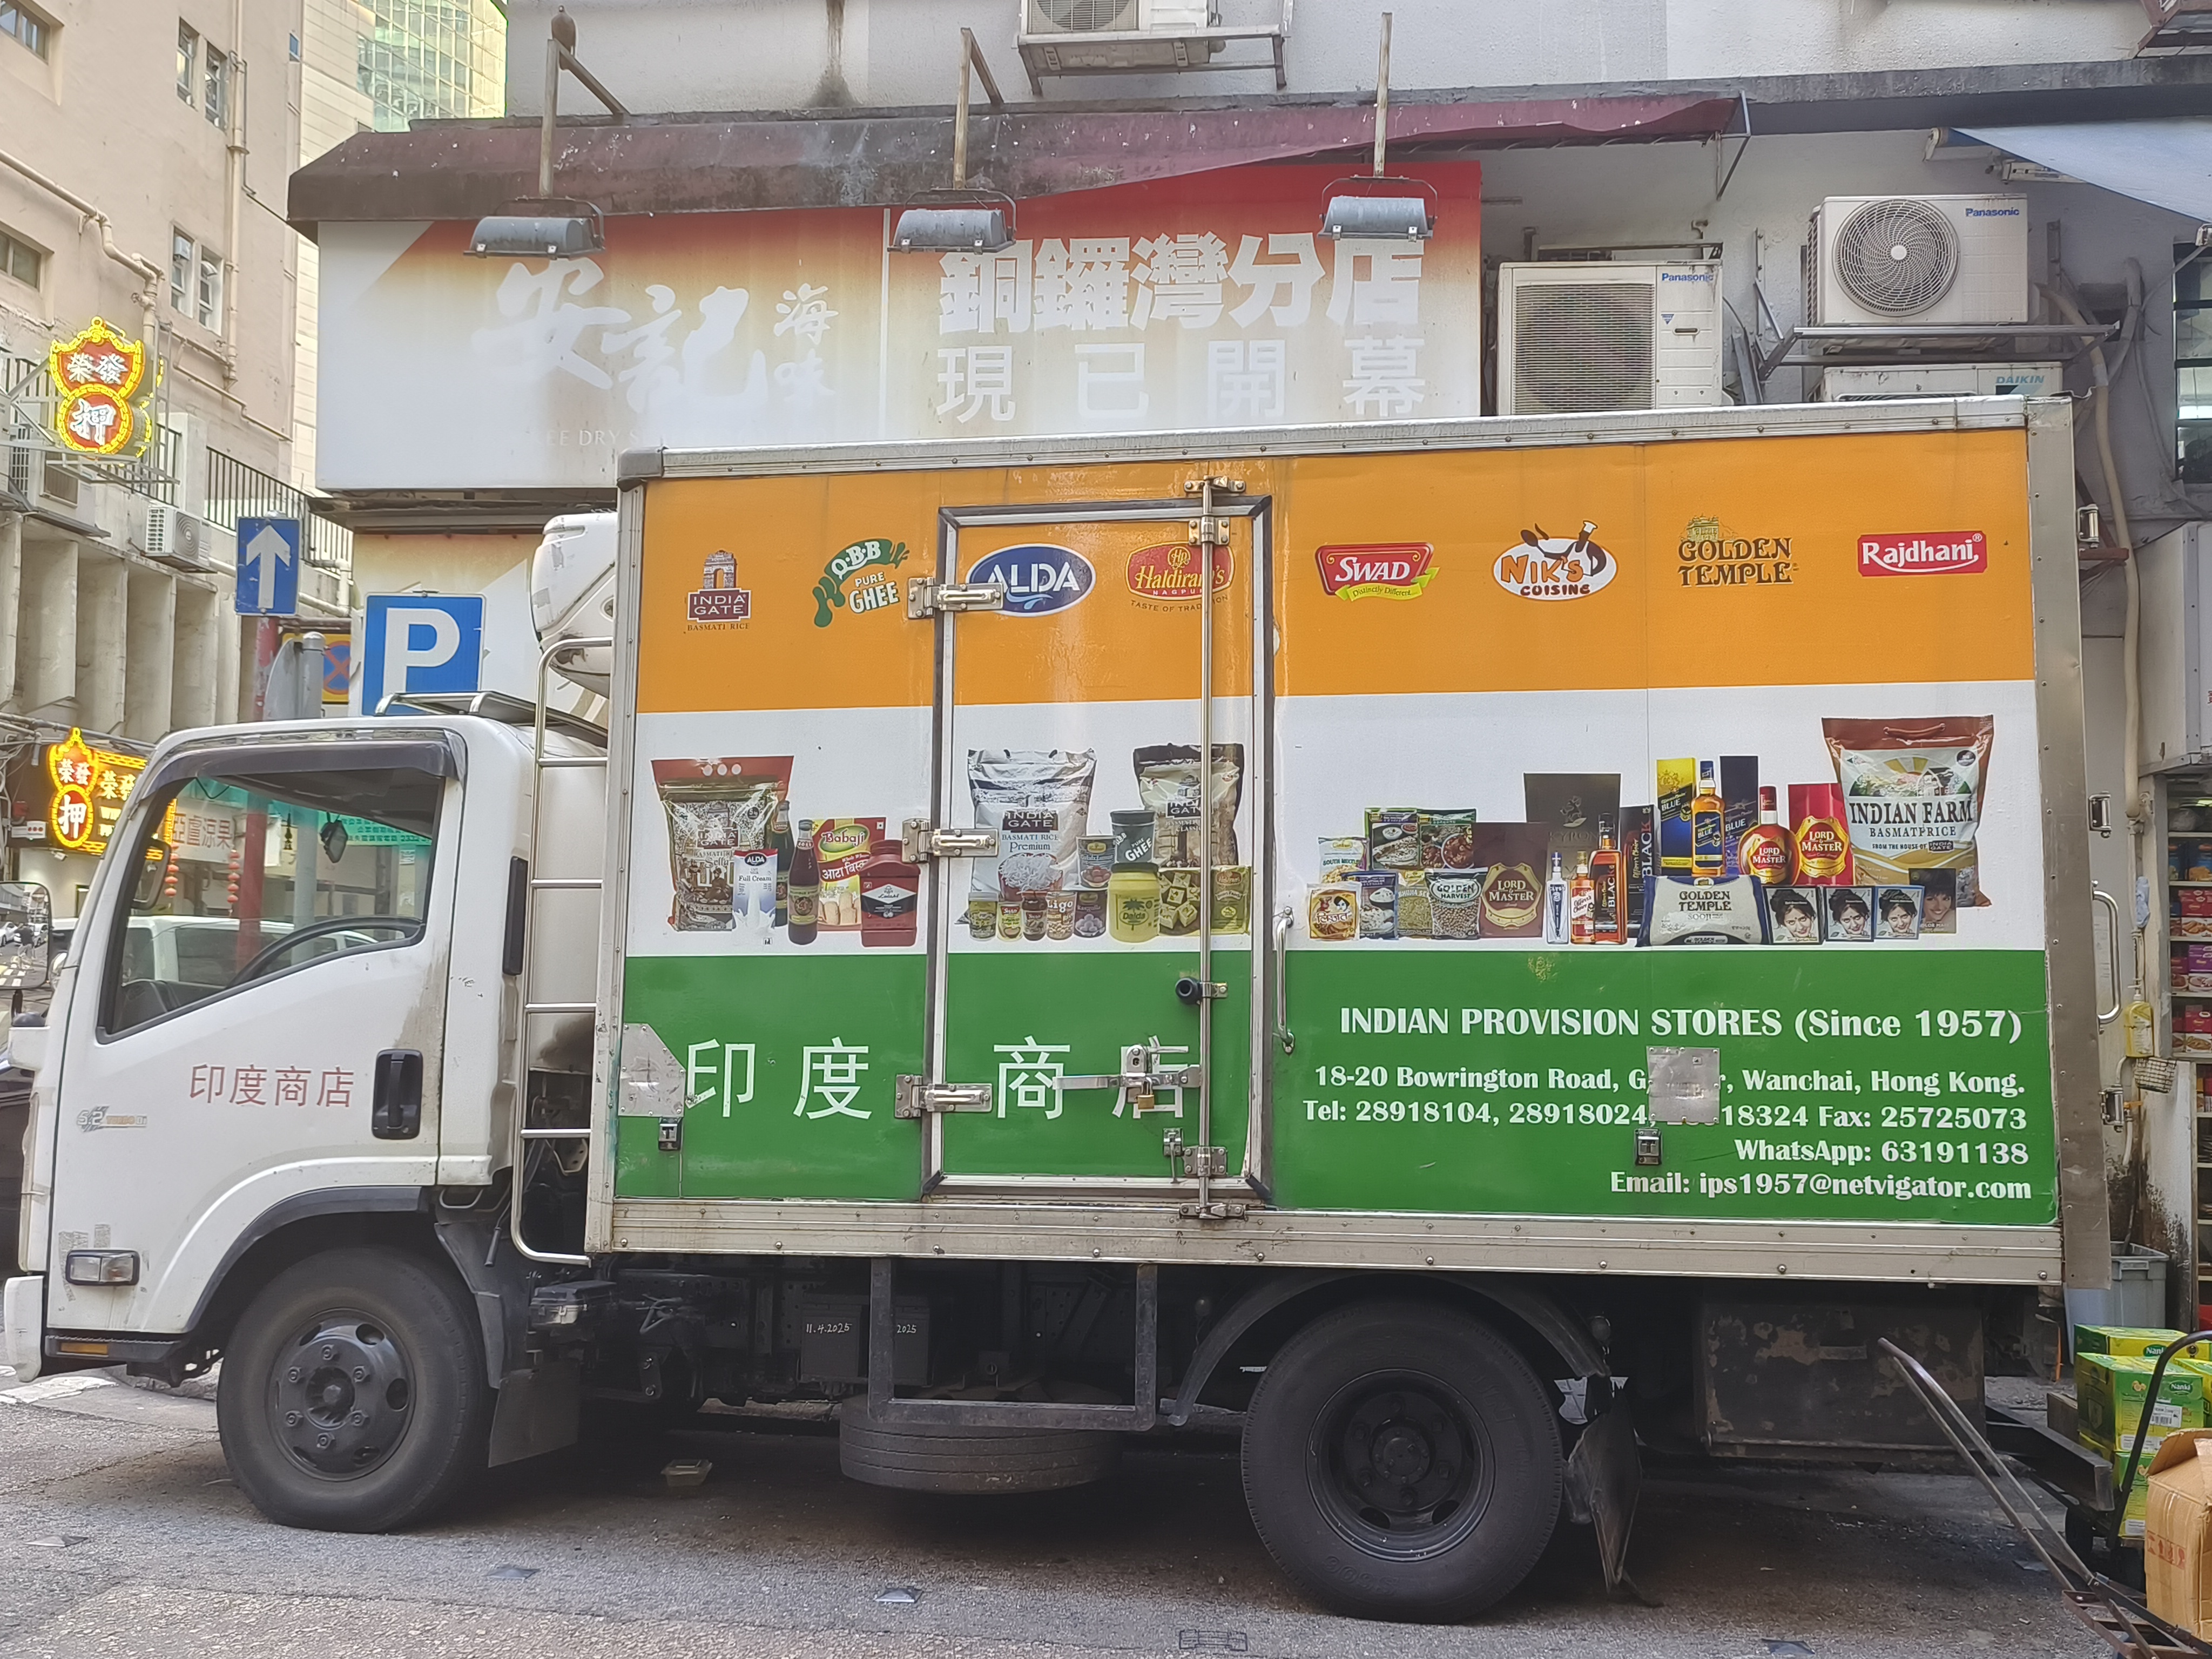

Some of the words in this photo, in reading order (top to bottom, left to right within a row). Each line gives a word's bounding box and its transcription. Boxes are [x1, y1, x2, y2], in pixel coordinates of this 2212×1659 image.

[1965, 207, 2020, 217] Panasonic
[939, 232, 1426, 334] 銅鑼灣分店
[1661, 272, 1714, 282] Panasonic
[936, 336, 1426, 424] 現已開幕
[1995, 375, 2045, 384] DAIKIN
[1677, 537, 1792, 563] GOLDEN
[1862, 539, 1979, 569] Rajdhani
[854, 571, 885, 588] PURE
[987, 562, 1080, 594] ALDA
[1134, 565, 1225, 590] Haldira's
[1677, 563, 1793, 588] TEMPLE
[693, 595, 746, 605] INDIA
[849, 581, 899, 614] GHEE
[694, 605, 744, 615] GATE
[1130, 599, 1159, 611] TASTE
[687, 623, 726, 631] BASMATI
[383, 608, 460, 691] P
[1661, 798, 1681, 811] BLUE
[59, 794, 87, 839] 押
[1007, 812, 1054, 820] INDIA
[1849, 802, 1917, 825] INDIAN
[1923, 800, 1973, 824] FARM
[1008, 819, 1053, 827] GATE
[1725, 818, 1746, 832] BLUE
[822, 828, 865, 847] Babaji
[1697, 828, 1713, 838] BLUE
[1809, 831, 1835, 841] LORD
[1926, 826, 1957, 837] RICE
[700, 838, 736, 846] GATE
[1009, 841, 1051, 853] Premium
[1801, 841, 1843, 852] MASTER
[1125, 838, 1152, 861] GHEE
[1641, 820, 1653, 878] BLACK
[1759, 847, 1780, 857] LORD
[1752, 855, 1786, 864] MASTER
[1437, 884, 1474, 893] GOLDEN
[1497, 880, 1526, 891] LORD
[1398, 889, 1418, 898] BHUJIA
[1489, 890, 1534, 902] MASTER
[1679, 891, 1730, 901] GOLDEN
[1047, 899, 1074, 913] Ligo
[1678, 900, 1732, 912] TEMPLE
[1340, 1007, 1448, 1034] INDIAN
[1461, 1008, 1639, 1035] PROVISION
[1651, 1008, 1783, 1036] STORES
[1795, 1008, 1901, 1043] (Since
[1914, 1009, 2022, 1044] 1957)
[685, 1035, 1190, 1120] 印度商店
[1315, 1065, 1388, 1087] 18-20
[1397, 1066, 1539, 1092] Bowrington
[1547, 1068, 1620, 1094] Road,
[1742, 1068, 1862, 1095] Wanchai,
[1871, 1070, 1940, 1096] Hong
[1948, 1071, 2025, 1097] Kong.
[190, 1063, 355, 1108] 印度商店
[1303, 1100, 1347, 1121] Tel:
[1355, 1101, 1500, 1127] 28918104,
[1509, 1102, 1656, 1127] 28918024,
[1818, 1105, 1871, 1127] Fax:
[1881, 1107, 2027, 1130] 25725073
[1734, 1138, 1872, 1166] WhatsApp:
[1881, 1141, 2029, 1165] 63191138
[1610, 1171, 1690, 1195] Email:
[1700, 1172, 2032, 1200] ips1957@netvigator.com
[806, 1323, 852, 1334] 11.4.2025
